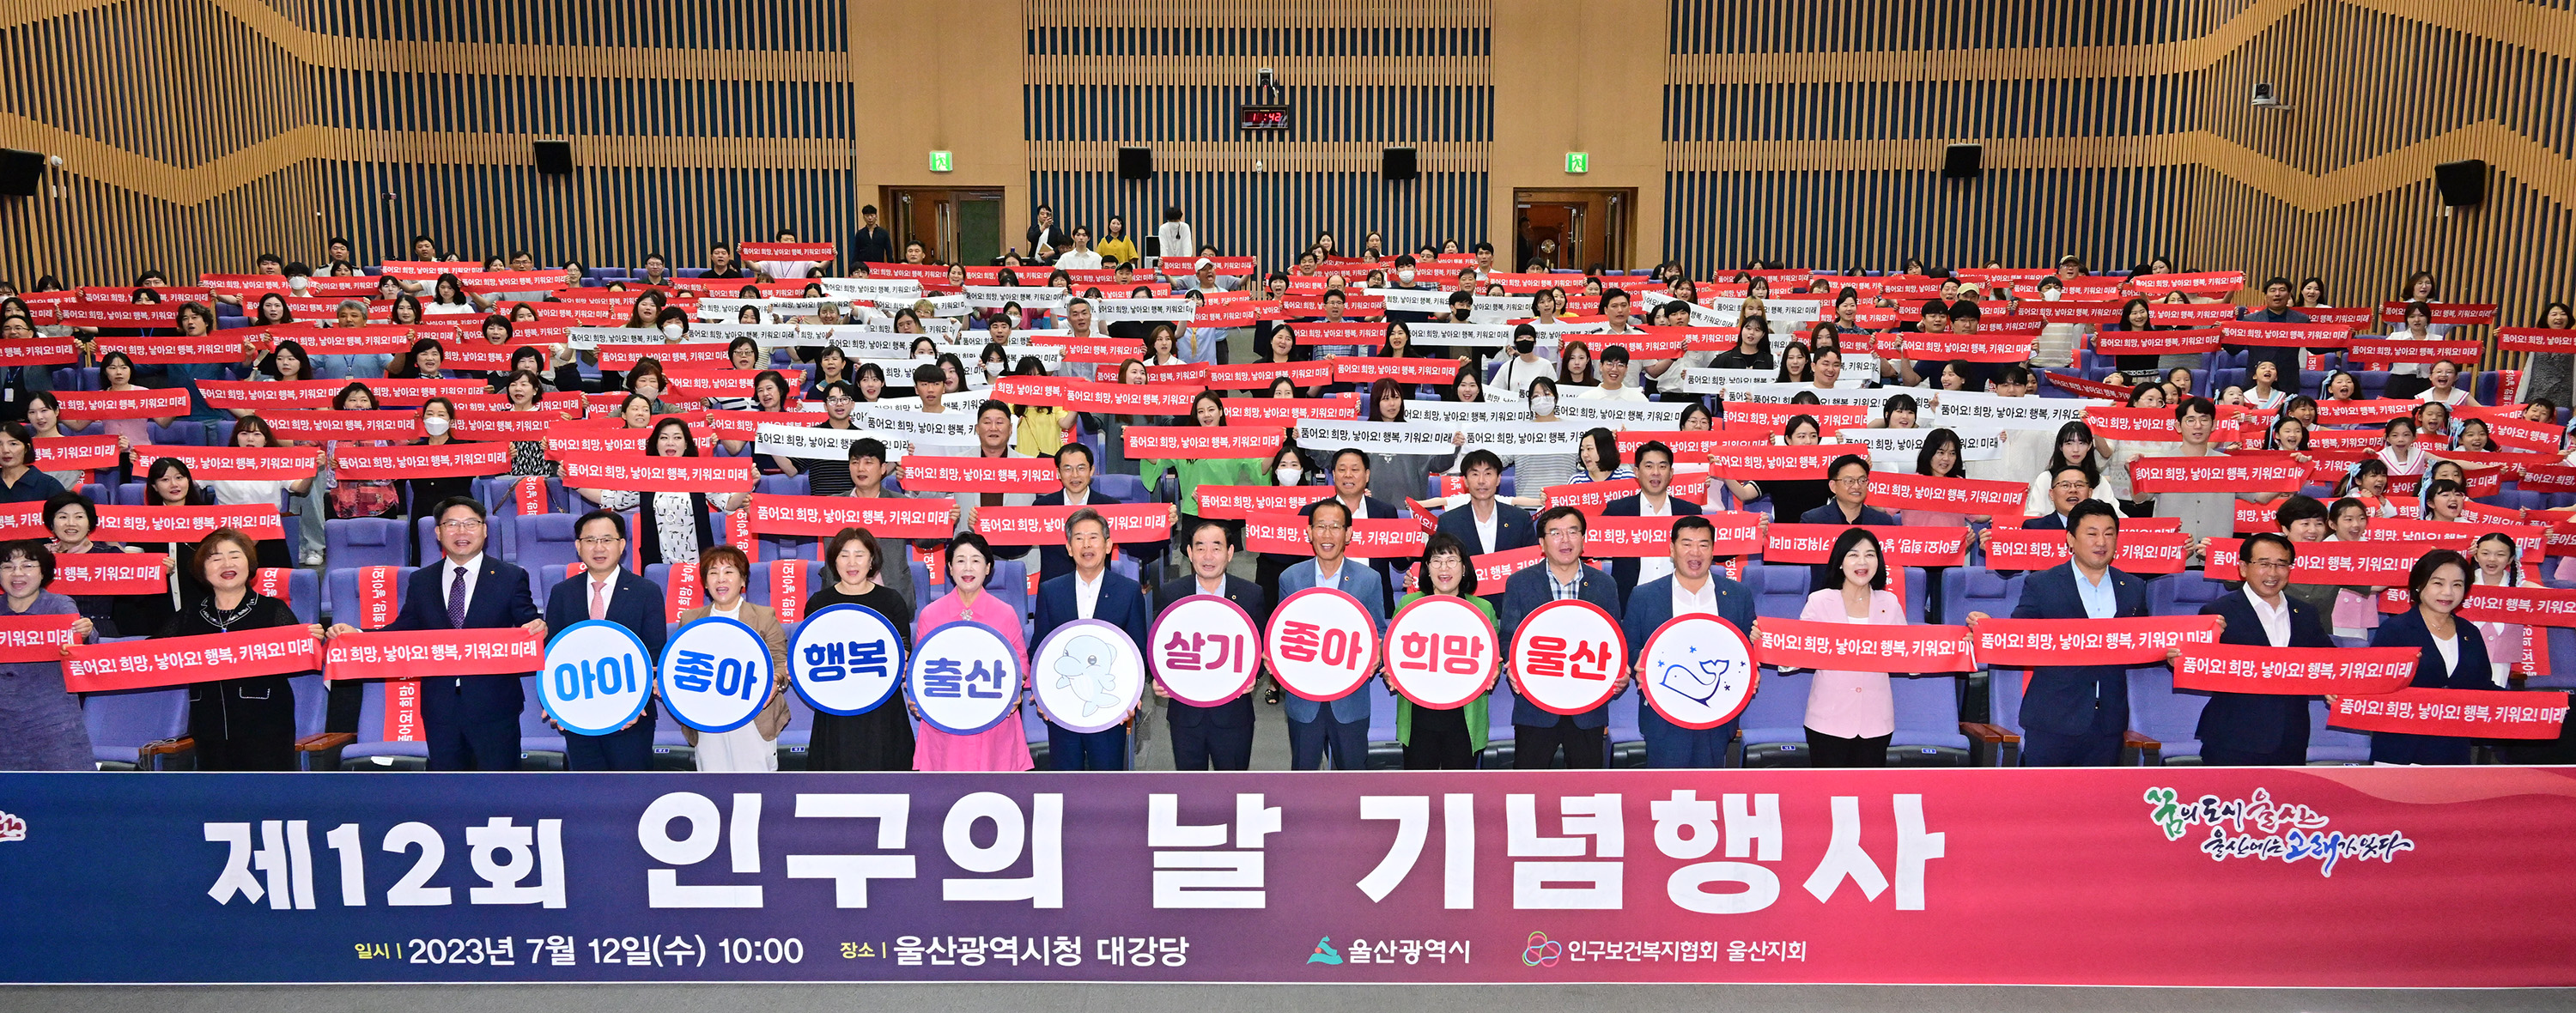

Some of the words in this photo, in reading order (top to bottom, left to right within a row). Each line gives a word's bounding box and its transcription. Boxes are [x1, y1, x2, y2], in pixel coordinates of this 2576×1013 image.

[2165, 338, 2180, 347] 행복,
[2182, 337, 2204, 345] 키워요!
[2206, 336, 2220, 344] 미래
[2223, 328, 2245, 337] 품어요!
[2247, 330, 2263, 338] 희망,
[2265, 330, 2288, 338] 낳아요!
[2290, 331, 2306, 339] 행복,
[2333, 331, 2348, 339] 미래
[129, 345, 147, 355] 희망,
[149, 346, 175, 355] 낳아요!
[178, 345, 196, 355] 행복,
[197, 344, 223, 354] 키워요!
[226, 344, 241, 353] 미래
[1926, 342, 1942, 352] 희망,
[1945, 343, 1969, 353] 낳아요!
[1971, 343, 1987, 354] 행복,
[1990, 344, 2014, 354] 키워요!
[2377, 347, 2392, 355] 희망,
[2420, 348, 2435, 356] 행복,
[2463, 348, 2477, 356] 미래
[1212, 373, 1233, 381] 품어요!
[1235, 372, 1250, 381] 희망,
[1251, 372, 1273, 380] 낳아요!
[1292, 369, 1314, 379] 키워요!
[1315, 367, 1328, 377] 미래
[1338, 365, 1359, 373] 품어요!
[1361, 365, 1376, 374] 희망,
[1378, 366, 1400, 374] 낳아요!
[1402, 366, 1416, 375] 행복,
[1419, 367, 1440, 375] 키워요!
[1442, 367, 1455, 376] 미래
[1130, 436, 1157, 447] 품어요!
[1160, 437, 1179, 448] 희망,
[1182, 437, 1209, 448] 낳아요!
[1212, 437, 1230, 448] 행복,
[1233, 436, 1261, 447] 키워요!
[1263, 435, 1279, 446] 미래
[1302, 428, 1328, 439] 품어요!
[1332, 429, 1350, 440] 희망,
[1353, 431, 1380, 441] 낳아요!
[1383, 432, 1401, 443] 행복,
[1405, 433, 1432, 443] 키워요!
[1435, 433, 1452, 443] 미래
[338, 458, 371, 469] 품어요!
[373, 457, 395, 468] 희망,
[397, 456, 428, 468] 낳아요!
[431, 455, 453, 467] 행복,
[455, 454, 485, 465] 키워요!
[488, 452, 506, 464] 미래
[568, 464, 602, 476] 품어요!
[605, 466, 628, 479] 희망,
[631, 467, 664, 479] 낳아요!
[667, 468, 690, 481] 행복,
[693, 468, 725, 481] 키워요!
[728, 469, 747, 481] 미래
[905, 467, 937, 479] 품어요!
[939, 468, 961, 481] 희망,
[963, 469, 995, 481] 낳아요!
[998, 470, 1019, 482] 행복,
[1023, 470, 1054, 482] 키워요!
[758, 506, 793, 520] 품어요!
[797, 508, 821, 523] 희망,
[823, 509, 860, 523] 낳아요!
[862, 511, 887, 525] 행복,
[890, 511, 925, 525] 키워요!
[928, 511, 949, 525] 미래
[1770, 536, 1791, 549] 미래
[1794, 537, 1829, 551] 키워요!
[1899, 538, 1923, 553] 희망,
[1924, 540, 1960, 554] 품어요!
[1280, 621, 1362, 670] 좋아
[1762, 632, 1801, 650] 품어요!
[1804, 636, 1832, 654] 희망,
[1836, 639, 1877, 655] 낳아요!
[1880, 640, 1909, 657] 행복,
[1912, 640, 1954, 658] 키워요!
[1982, 634, 2023, 649] 품어요!
[2027, 634, 2056, 650] 희망,
[2060, 634, 2102, 650] 낳아요!
[2106, 633, 2135, 649] 행복,
[2139, 632, 2183, 648] 키워요!
[2187, 630, 2212, 643] 미래
[70, 659, 117, 676] 품어요!
[119, 655, 153, 672] 희망,
[155, 652, 202, 670] 낳아요!
[204, 647, 237, 665] 행복,
[240, 642, 285, 661] 키워요!
[288, 639, 313, 655] 미래
[350, 646, 380, 662] 희망,
[384, 646, 428, 662] 낳아요!
[431, 645, 461, 660] 행복,
[465, 643, 507, 659] 키워요!
[512, 640, 537, 658] 미래
[804, 640, 887, 682] 행복
[1165, 632, 1243, 672] 살기
[1400, 632, 1484, 675] 희망
[1527, 636, 1612, 681] 울산
[555, 653, 636, 701] 아이
[674, 650, 756, 700] 좋아
[924, 658, 1006, 698] 출산
[2184, 657, 2226, 674] 품어요!
[2229, 660, 2257, 678] 희망,
[2262, 662, 2305, 678] 낳아요!
[2308, 663, 2336, 679] 행복,
[2340, 663, 2384, 678] 키워요!
[2385, 662, 2413, 678] 미래
[2341, 699, 2384, 715] 품어요!
[2385, 701, 2415, 719] 희망,
[2419, 703, 2460, 719] 낳아요!
[2464, 706, 2491, 722] 행복,
[2495, 707, 2538, 723] 키워요!
[2541, 707, 2567, 724] 미래
[2202, 797, 2242, 828] 도시
[2245, 789, 2326, 827] 울산
[204, 817, 566, 909] 제12회
[639, 792, 1063, 908] 인구의
[1148, 794, 1281, 908] 날
[1357, 790, 1945, 913] 기념행사
[2203, 828, 2285, 858] 울산에는
[355, 943, 389, 959] 일시
[409, 937, 514, 965] 2023년
[526, 936, 575, 965] 7월
[589, 935, 705, 967] 12일(수)
[720, 938, 803, 963] 10:00
[841, 942, 875, 958] 장소
[894, 937, 1081, 966] 울산광역시청
[1097, 937, 1189, 966] 대강당
[1349, 939, 1469, 964] 울산광역시
[1569, 941, 1717, 961] 인구보건복지협회
[1727, 941, 1806, 961] 울산지회
